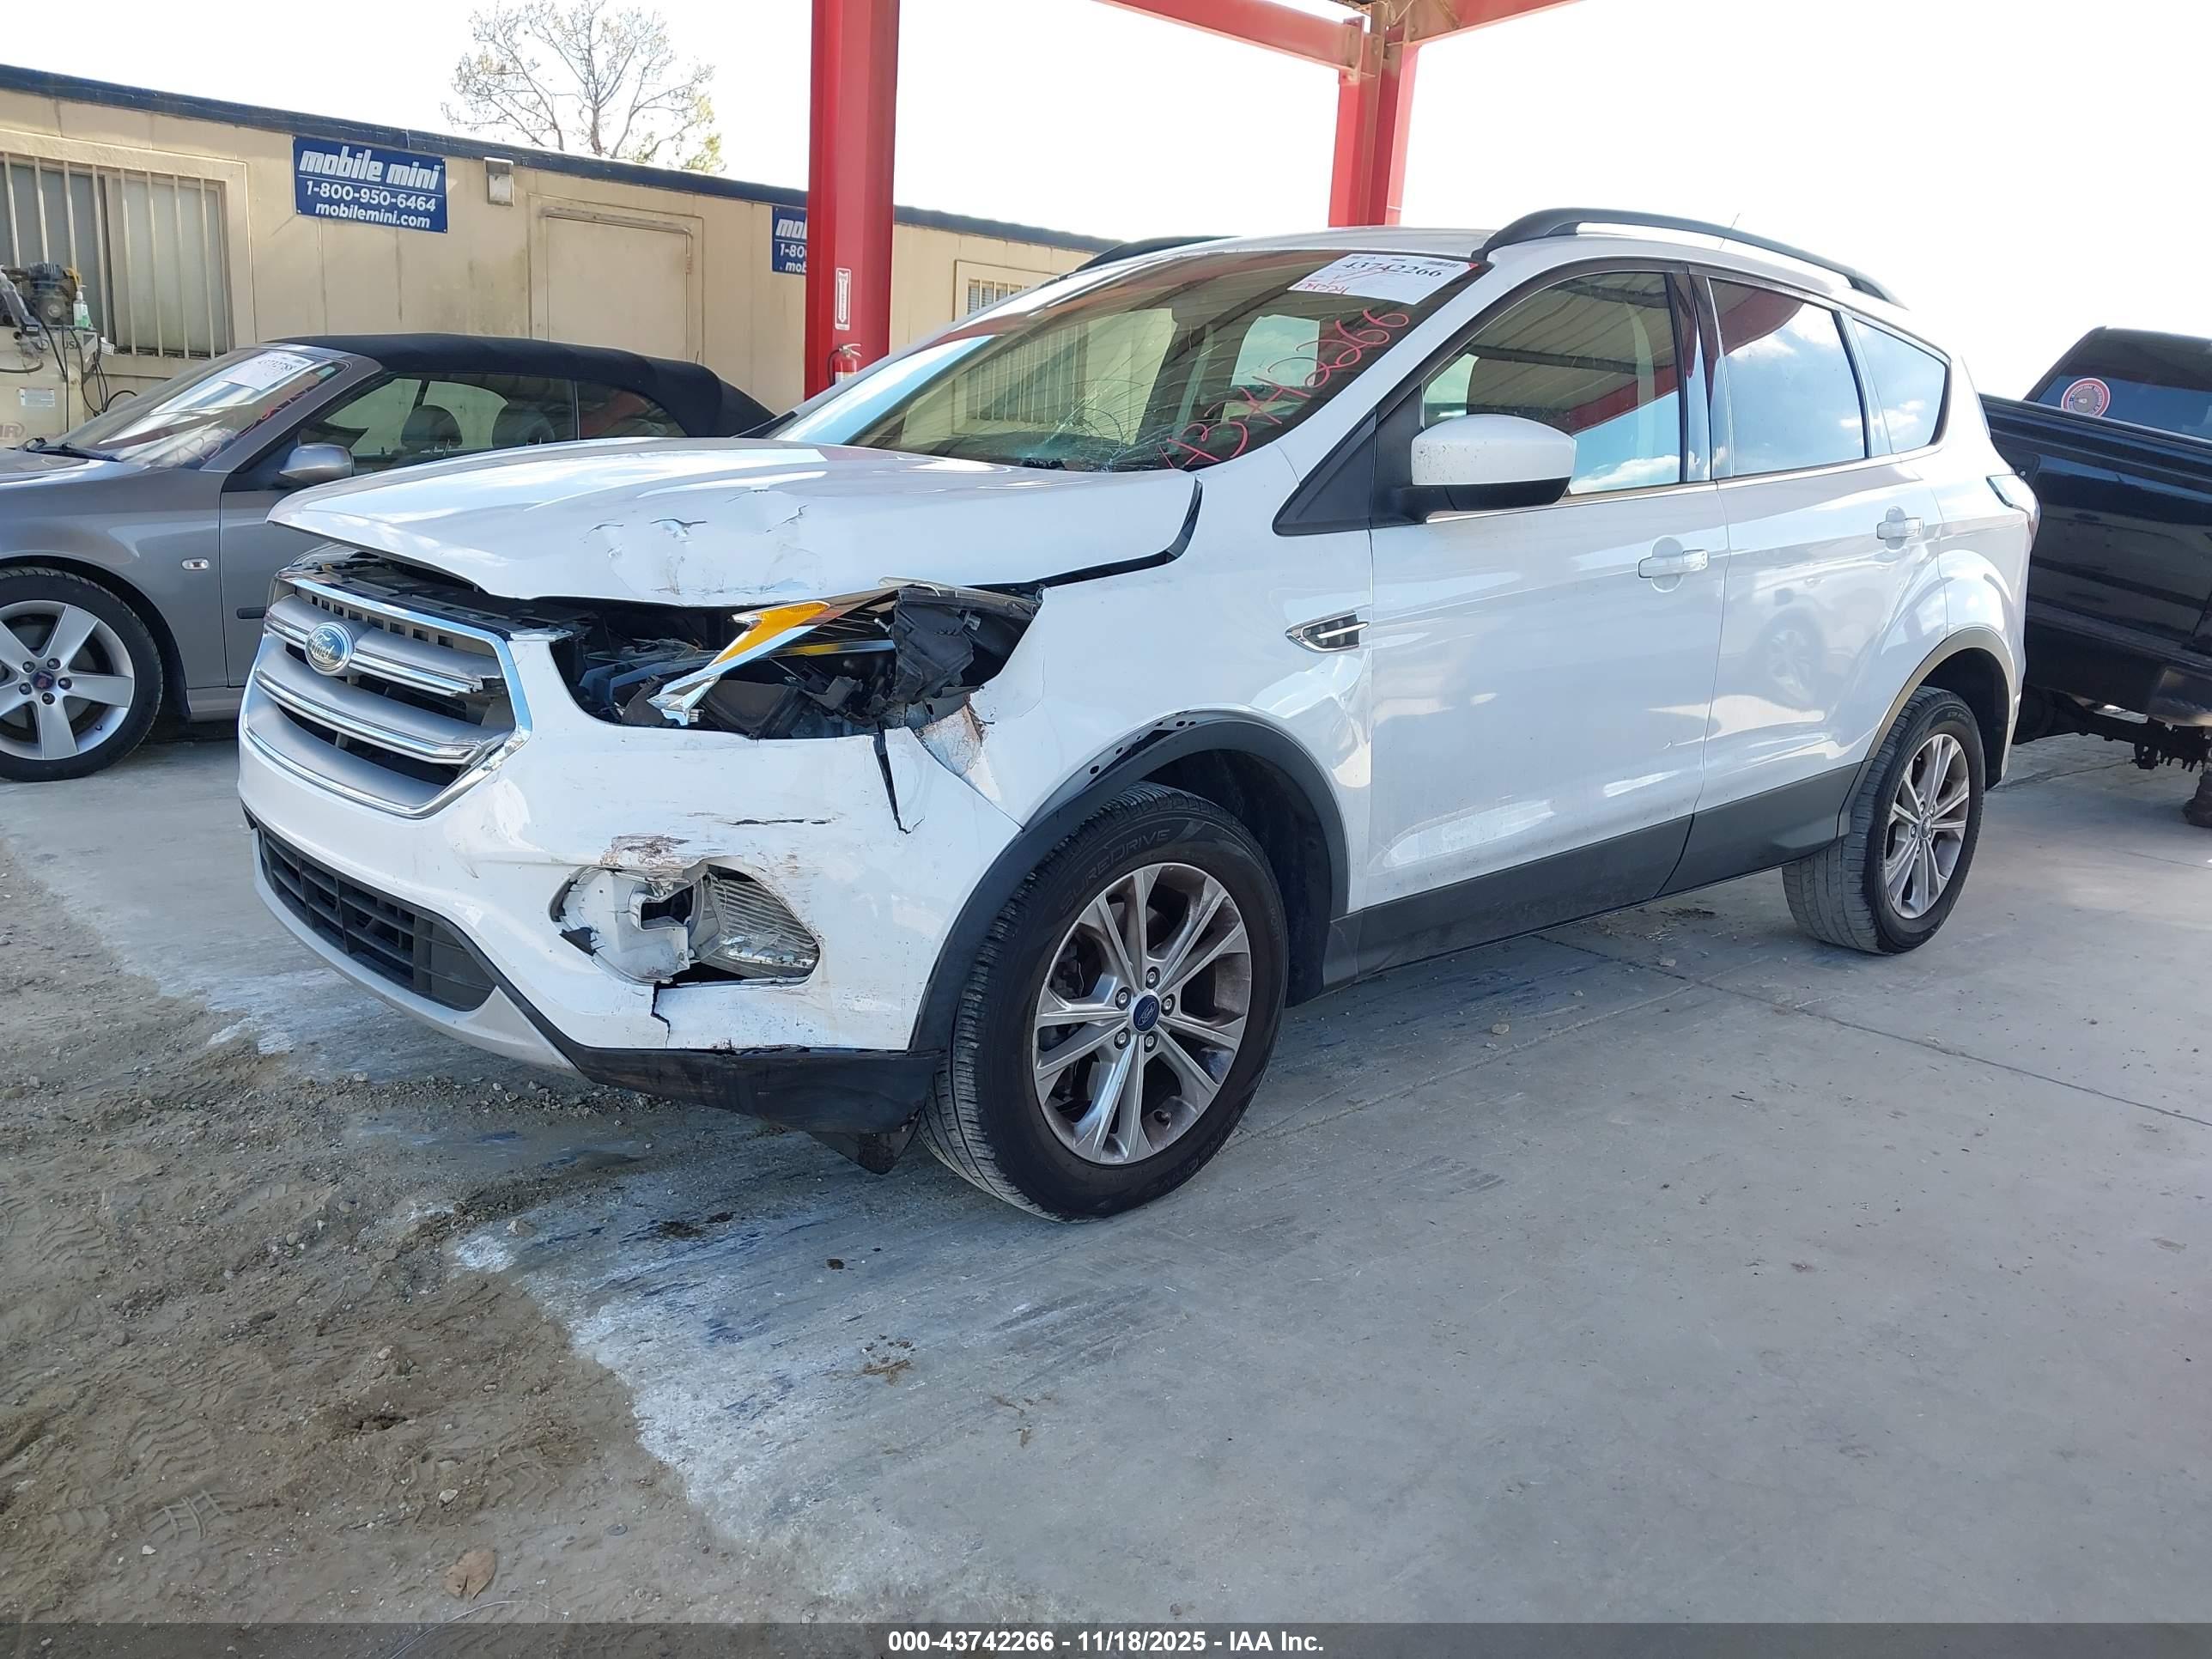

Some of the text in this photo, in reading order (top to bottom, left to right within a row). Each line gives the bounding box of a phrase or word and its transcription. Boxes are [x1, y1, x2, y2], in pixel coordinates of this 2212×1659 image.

[299, 146, 441, 190] mobile mini
[306, 180, 436, 211] 1-800-950-6464
[315, 203, 430, 228] mobilemini.com
[780, 243, 807, 258] 1-80
[309, 631, 336, 661] Ford
